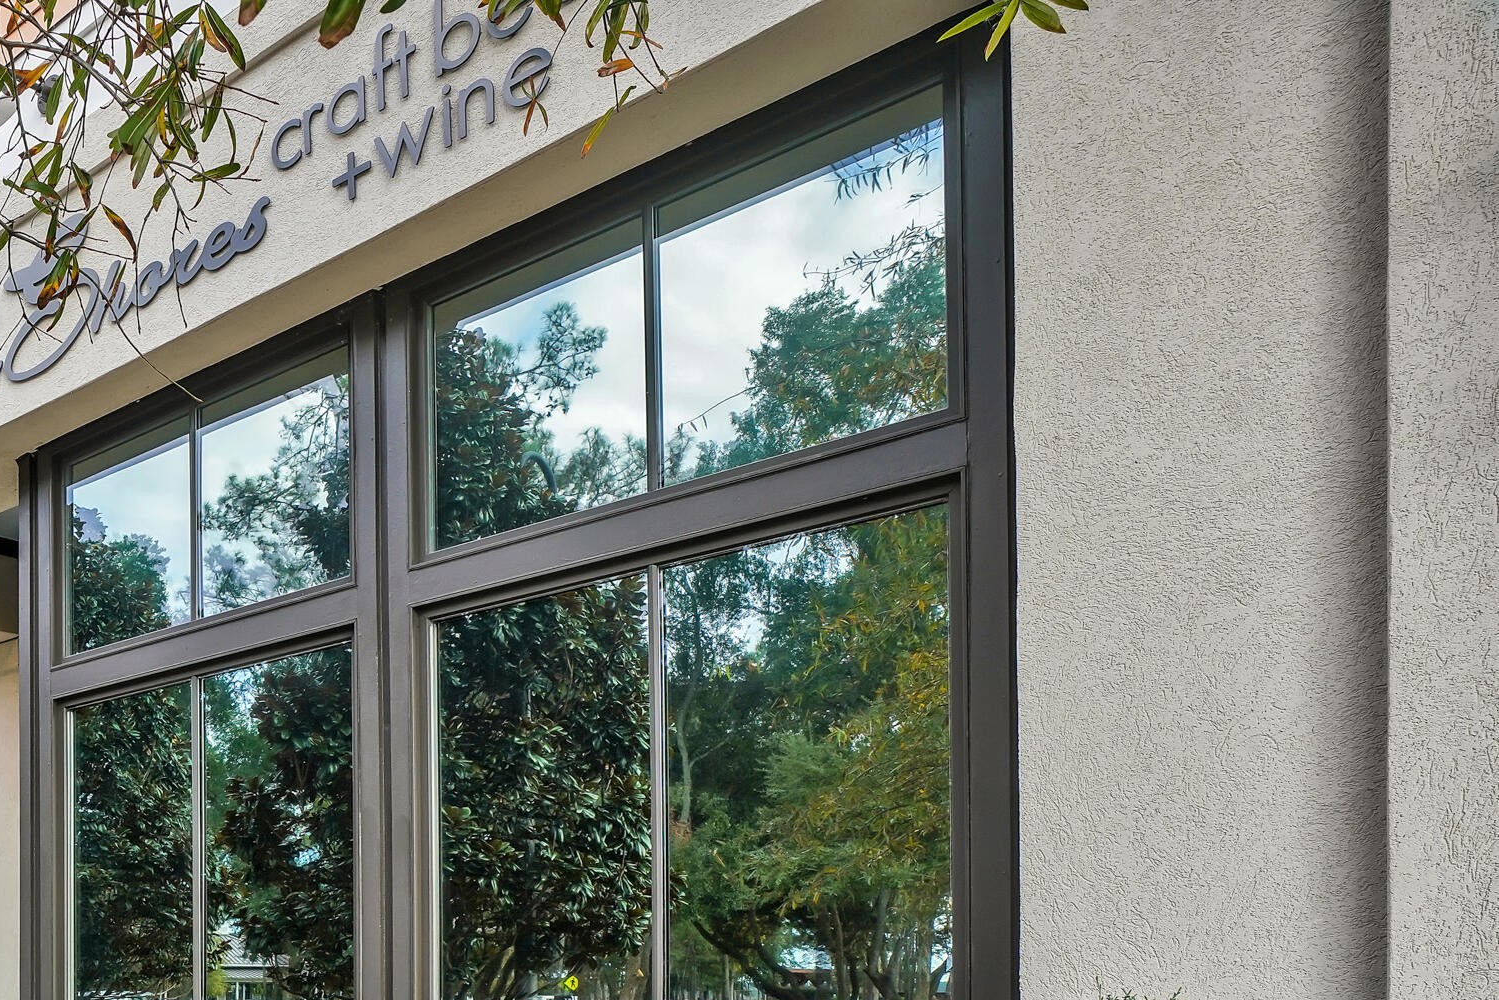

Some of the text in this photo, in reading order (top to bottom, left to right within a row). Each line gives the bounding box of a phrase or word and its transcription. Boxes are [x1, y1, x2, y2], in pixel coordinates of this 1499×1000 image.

[270, 22, 417, 171] craft
[331, 46, 553, 202] +wine
[4, 194, 272, 383] Shores
